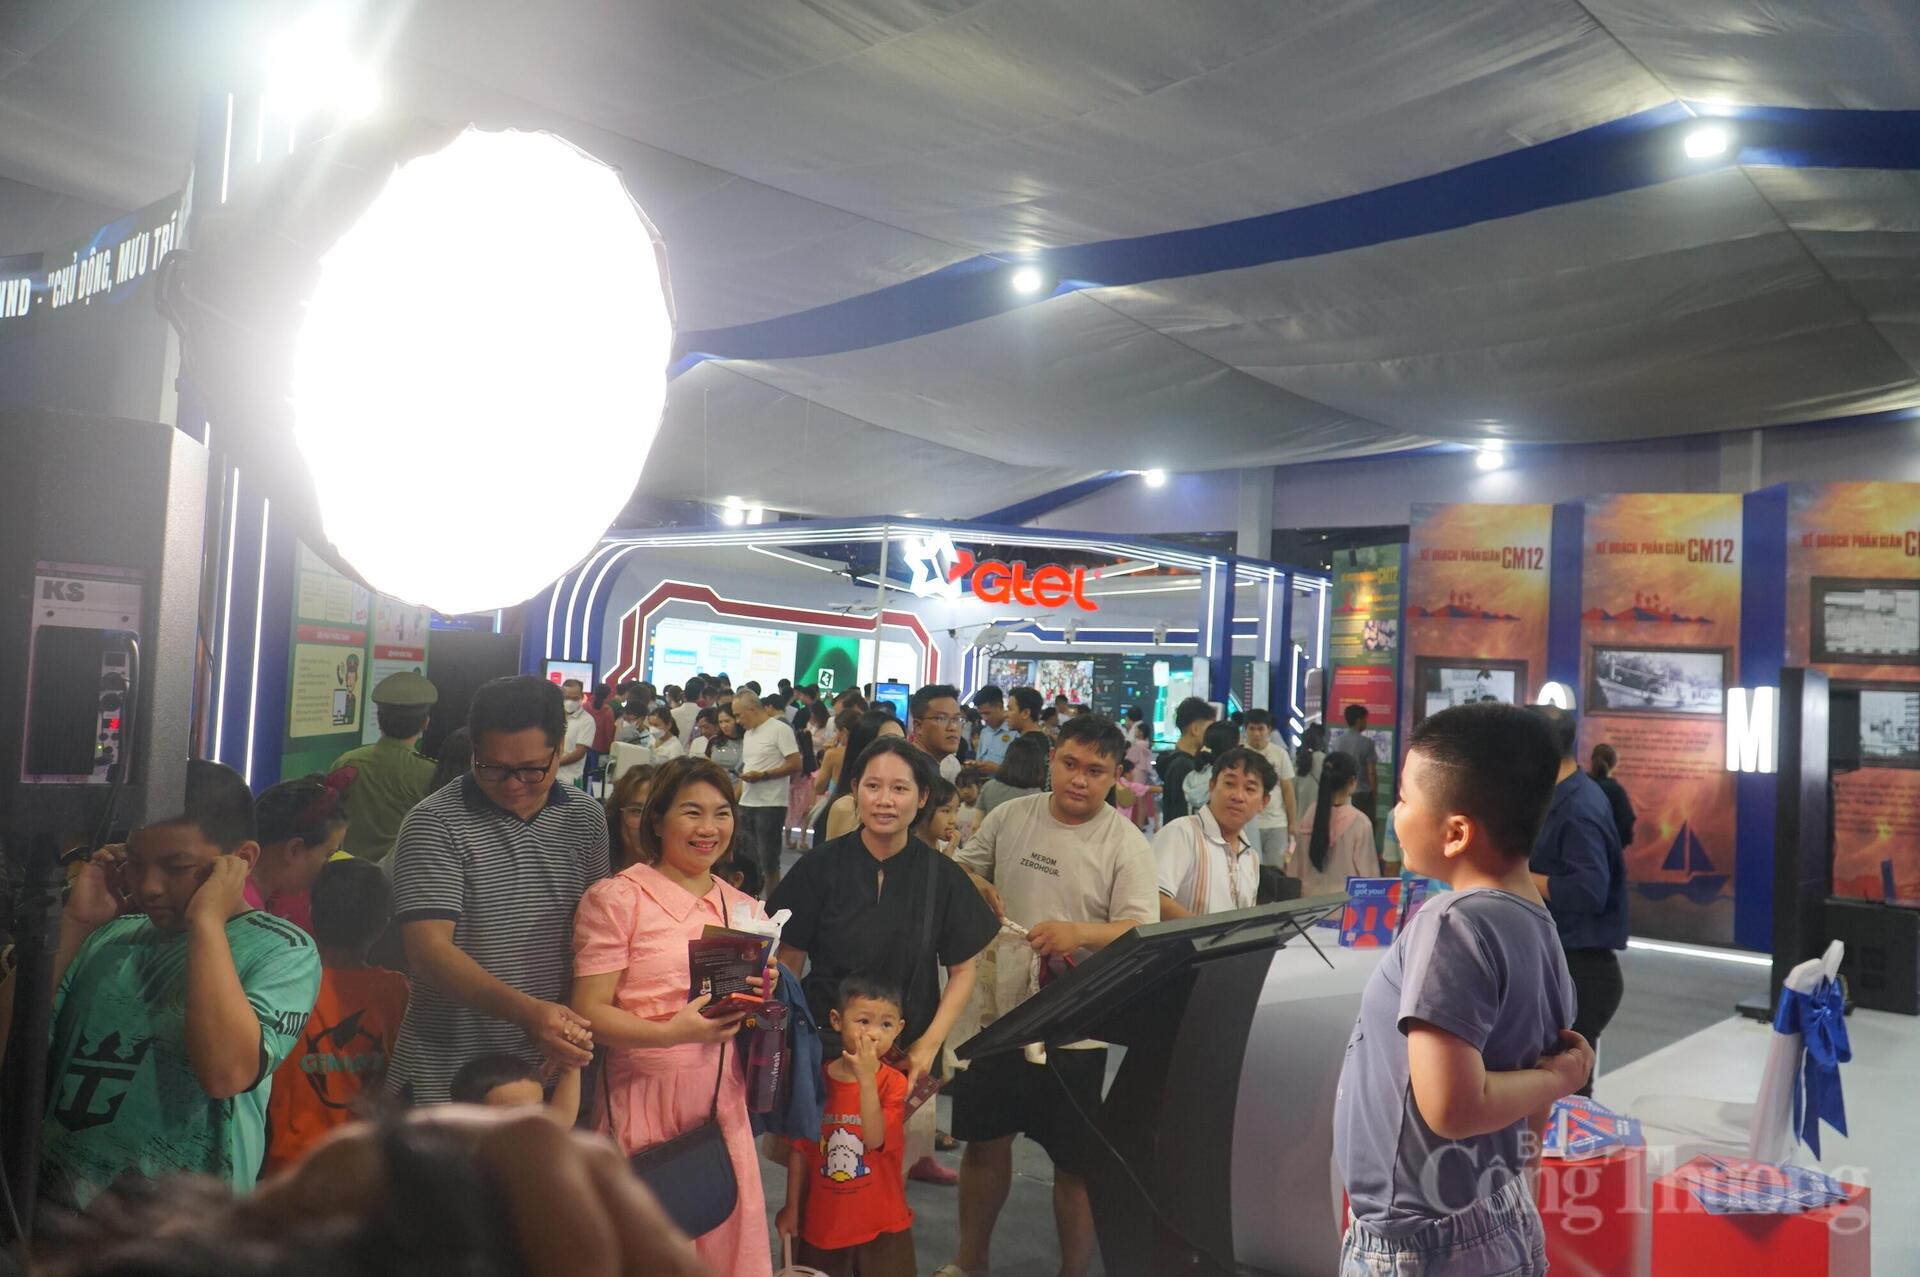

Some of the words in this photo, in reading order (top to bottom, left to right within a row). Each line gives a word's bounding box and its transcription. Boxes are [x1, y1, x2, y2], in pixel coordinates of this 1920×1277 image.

[116, 231, 150, 285] MƯU
[1501, 546, 1544, 570] CM12
[1687, 537, 1735, 564] CM12
[42, 579, 86, 602] KS
[1354, 888, 1367, 897] got
